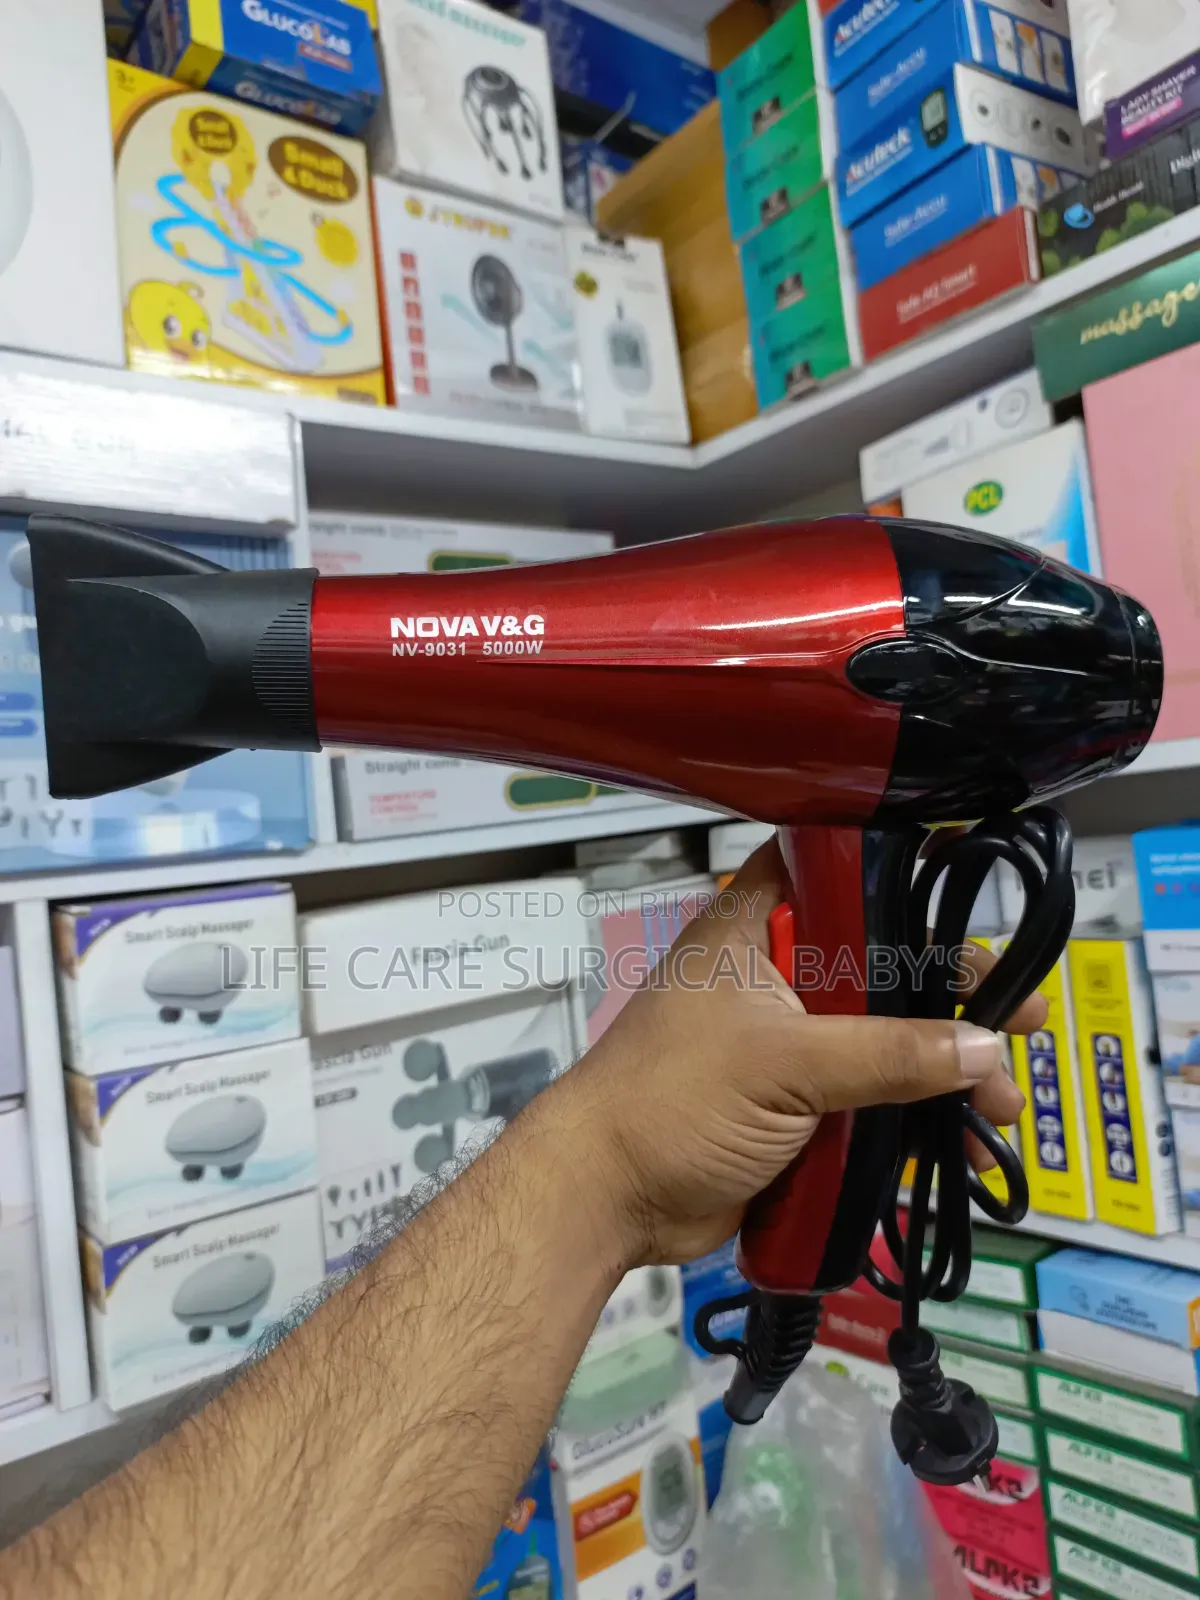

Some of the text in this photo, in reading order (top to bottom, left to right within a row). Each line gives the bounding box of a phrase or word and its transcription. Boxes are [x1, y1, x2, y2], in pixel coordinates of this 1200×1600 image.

[390, 613, 546, 638] NOVA V&G
[392, 640, 544, 656] NV-9031 5000W
[365, 758, 421, 775] Straight
[124, 918, 256, 945] Smart Scalp Massager
[145, 1068, 273, 1105] Smart Scalp Massager
[152, 1222, 281, 1269] Smart Scalp Massager
